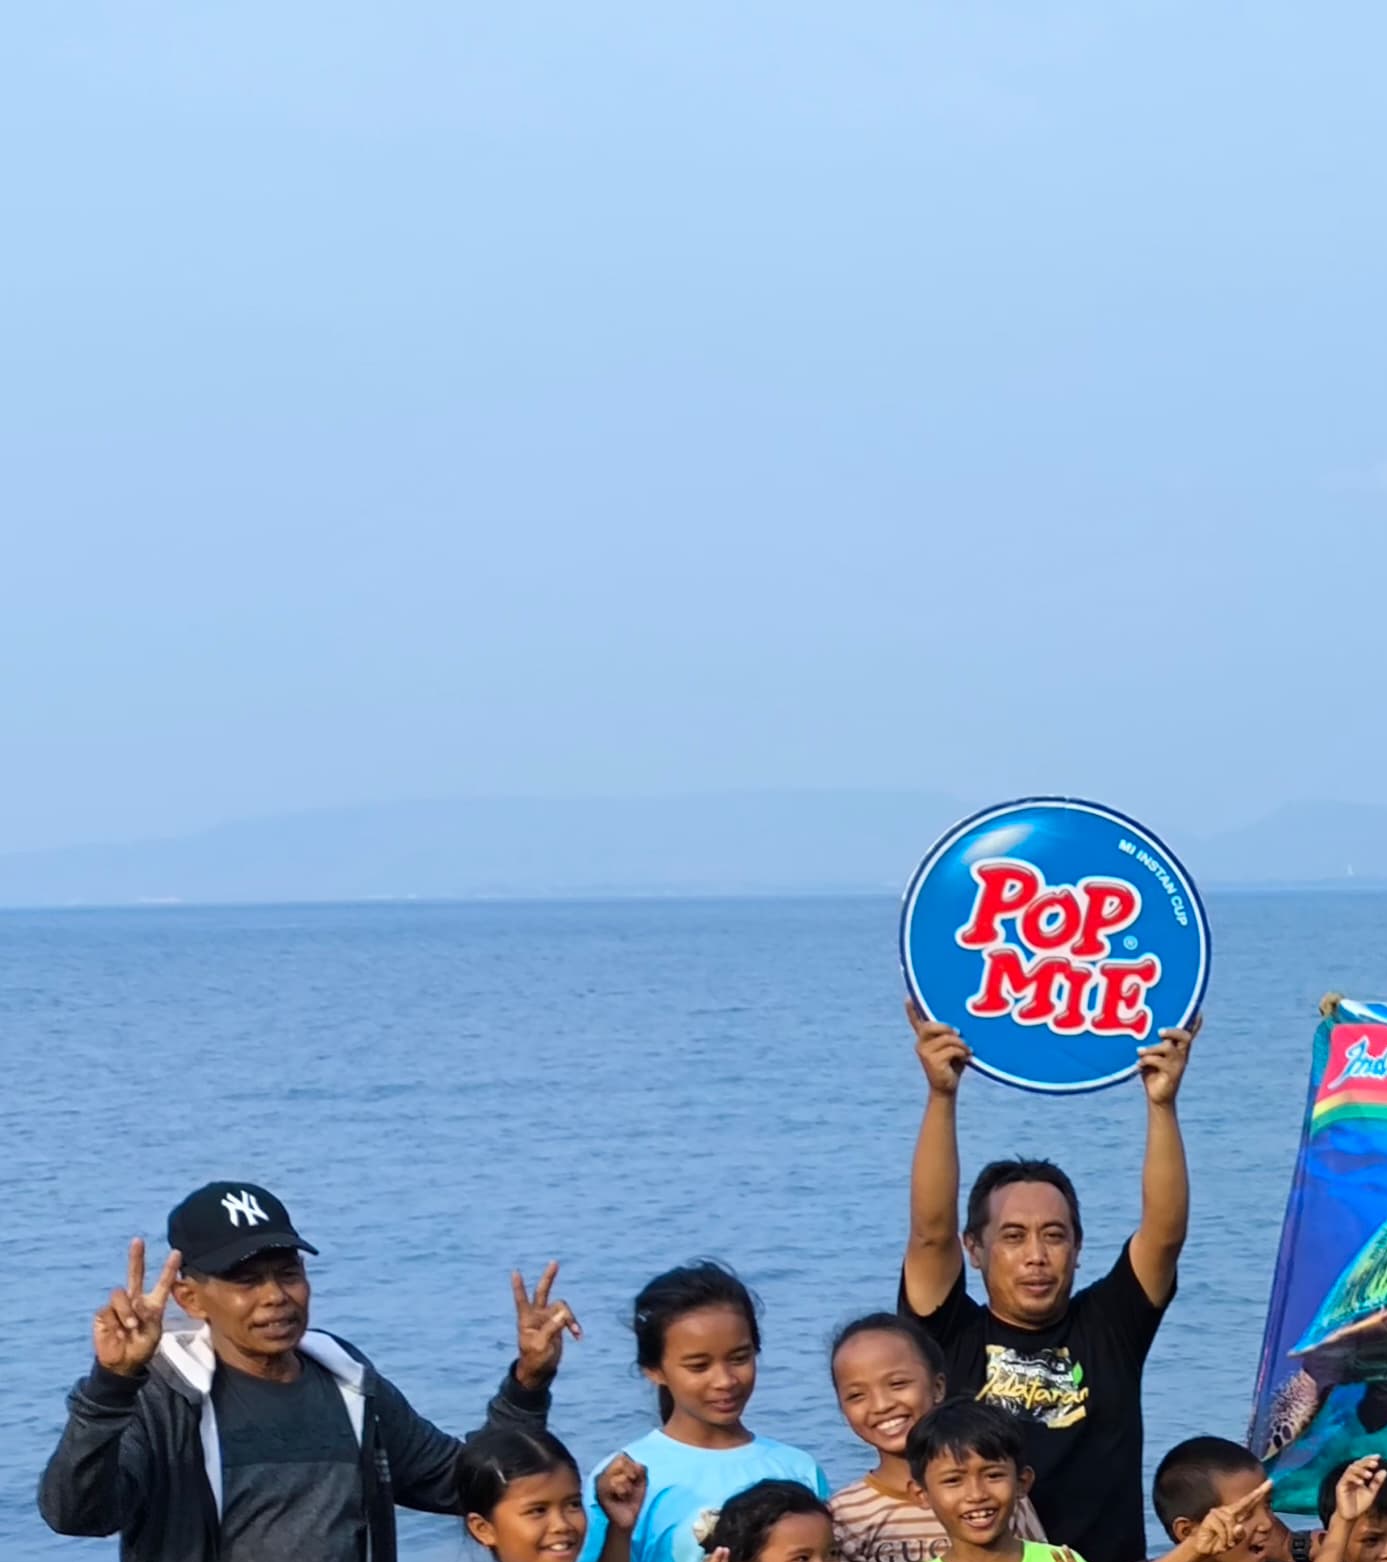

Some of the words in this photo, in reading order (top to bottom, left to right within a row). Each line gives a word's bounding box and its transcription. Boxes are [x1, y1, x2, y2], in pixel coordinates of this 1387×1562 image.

[958, 860, 1138, 958] POP
[1118, 838, 1137, 855] MI
[1136, 850, 1178, 895] INSTAN
[1170, 895, 1188, 926] CUP
[969, 949, 1160, 1038] MIE
